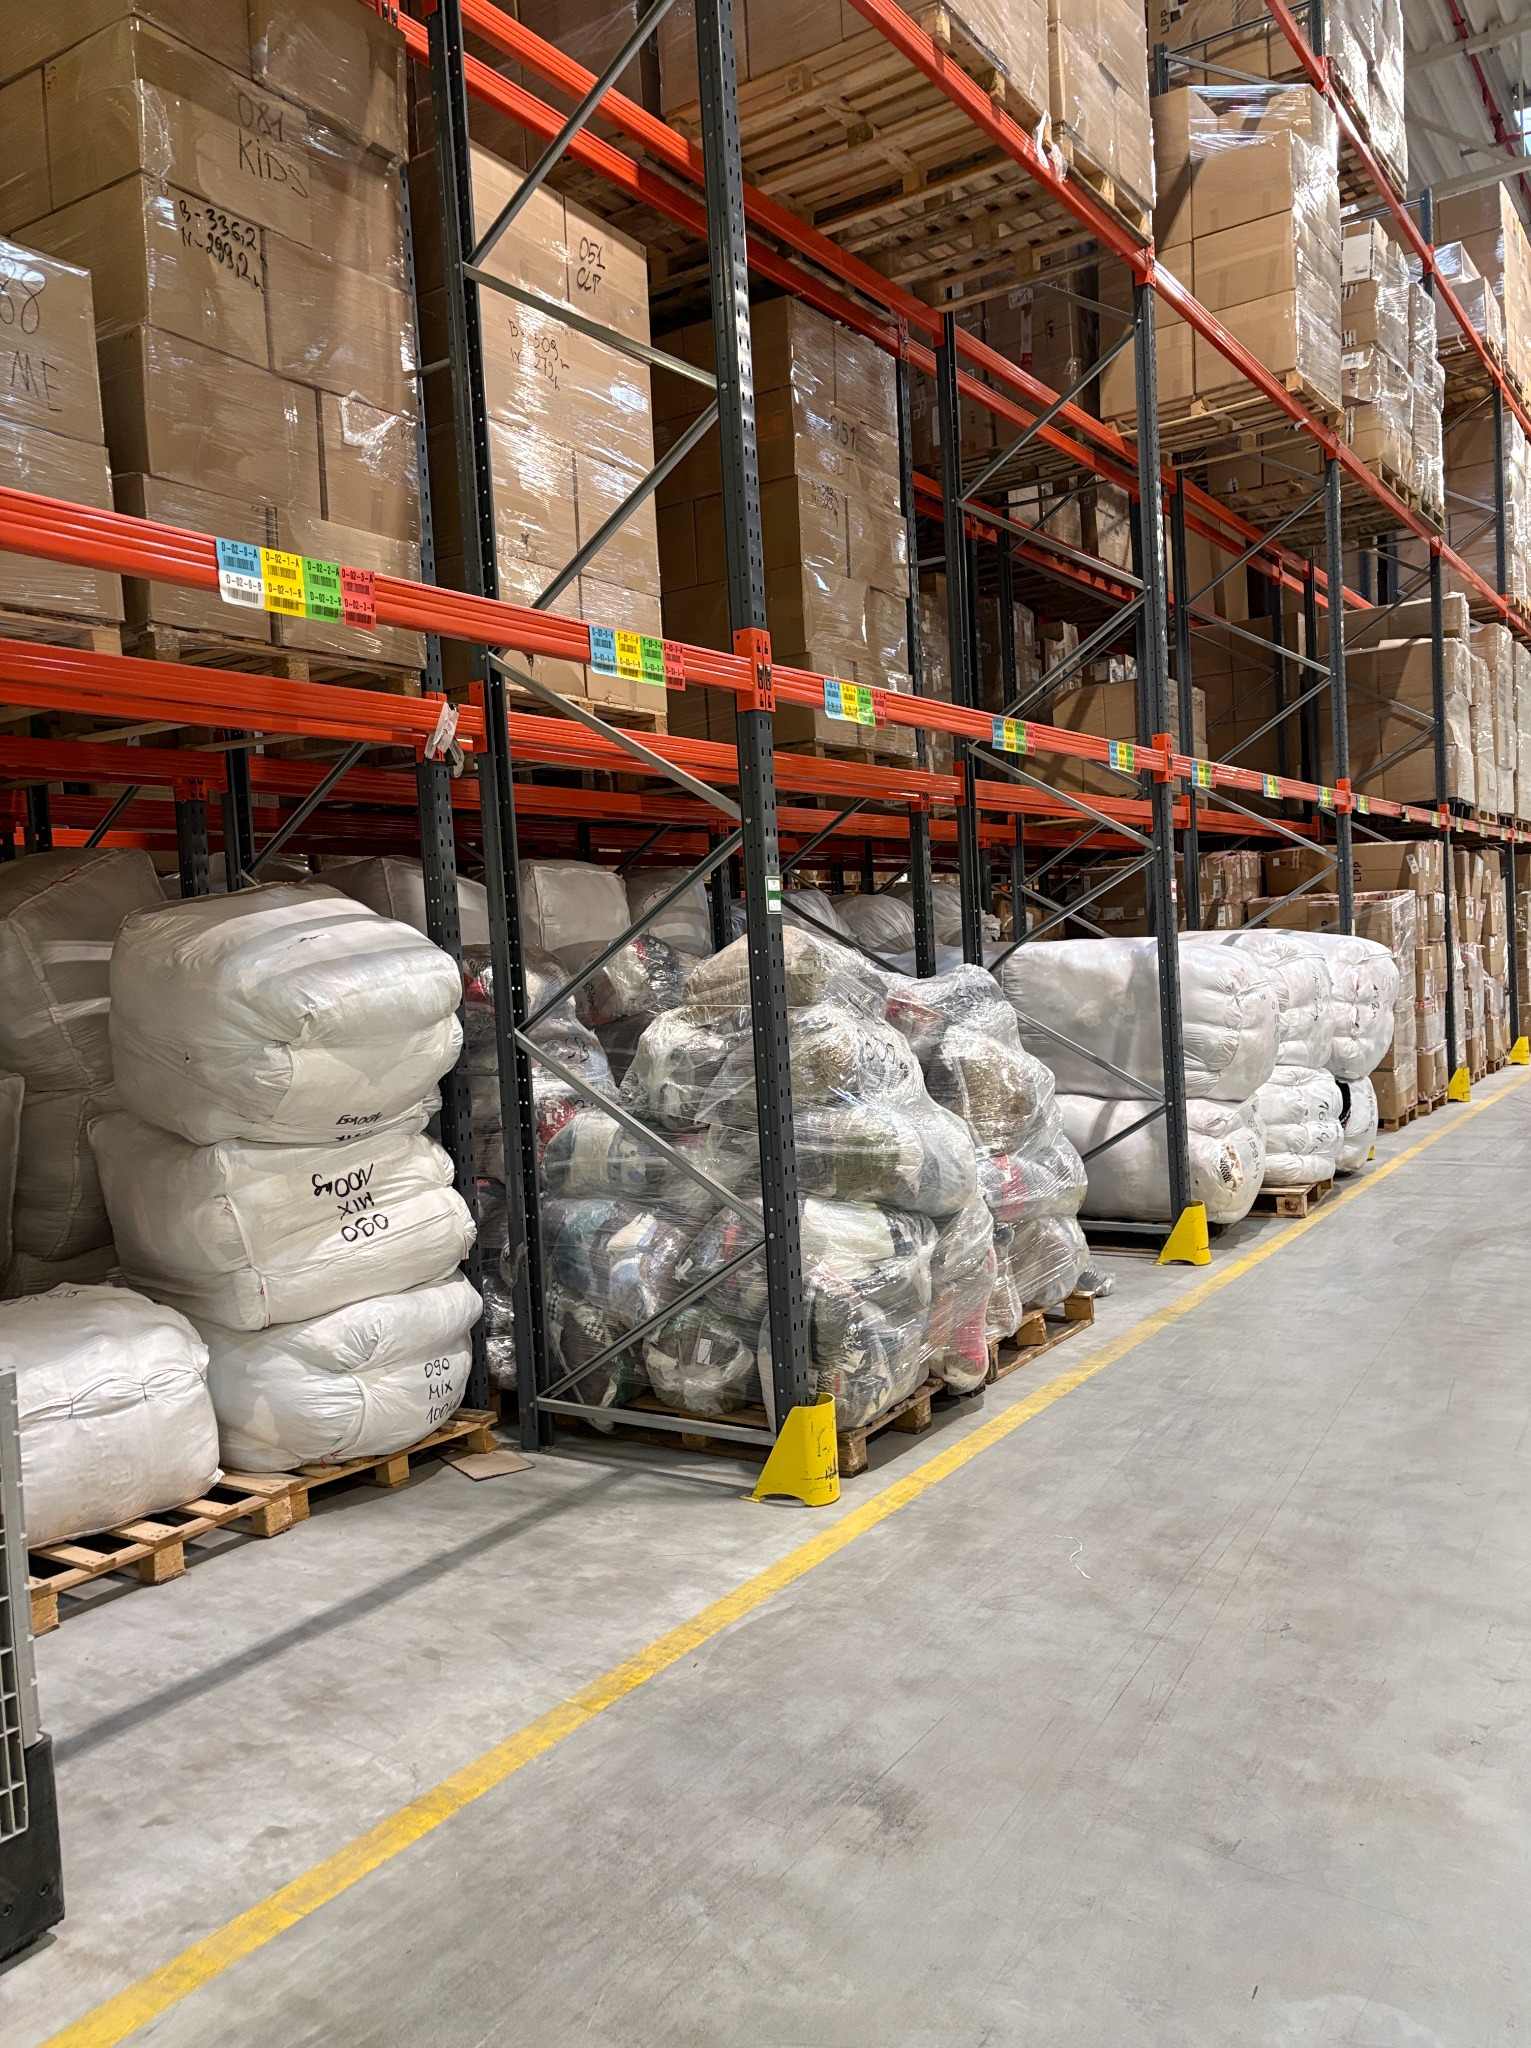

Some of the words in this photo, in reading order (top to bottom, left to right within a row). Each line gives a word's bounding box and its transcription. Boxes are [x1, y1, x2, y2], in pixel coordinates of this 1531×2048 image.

[1160, 9, 1170, 35] LPP
[237, 92, 284, 143] 081
[578, 236, 606, 270] 051
[221, 541, 258, 559] D-02-0-A
[265, 551, 300, 568] D-02-1-A
[307, 560, 340, 577] D-02-2-A
[341, 568, 374, 583] D-02-3-A
[225, 574, 262, 591] D-02-0-B
[268, 583, 302, 599] D-02-1-B
[1353, 861, 1362, 882] LPP
[337, 1191, 375, 1220] MIX
[424, 1357, 451, 1378] 090
